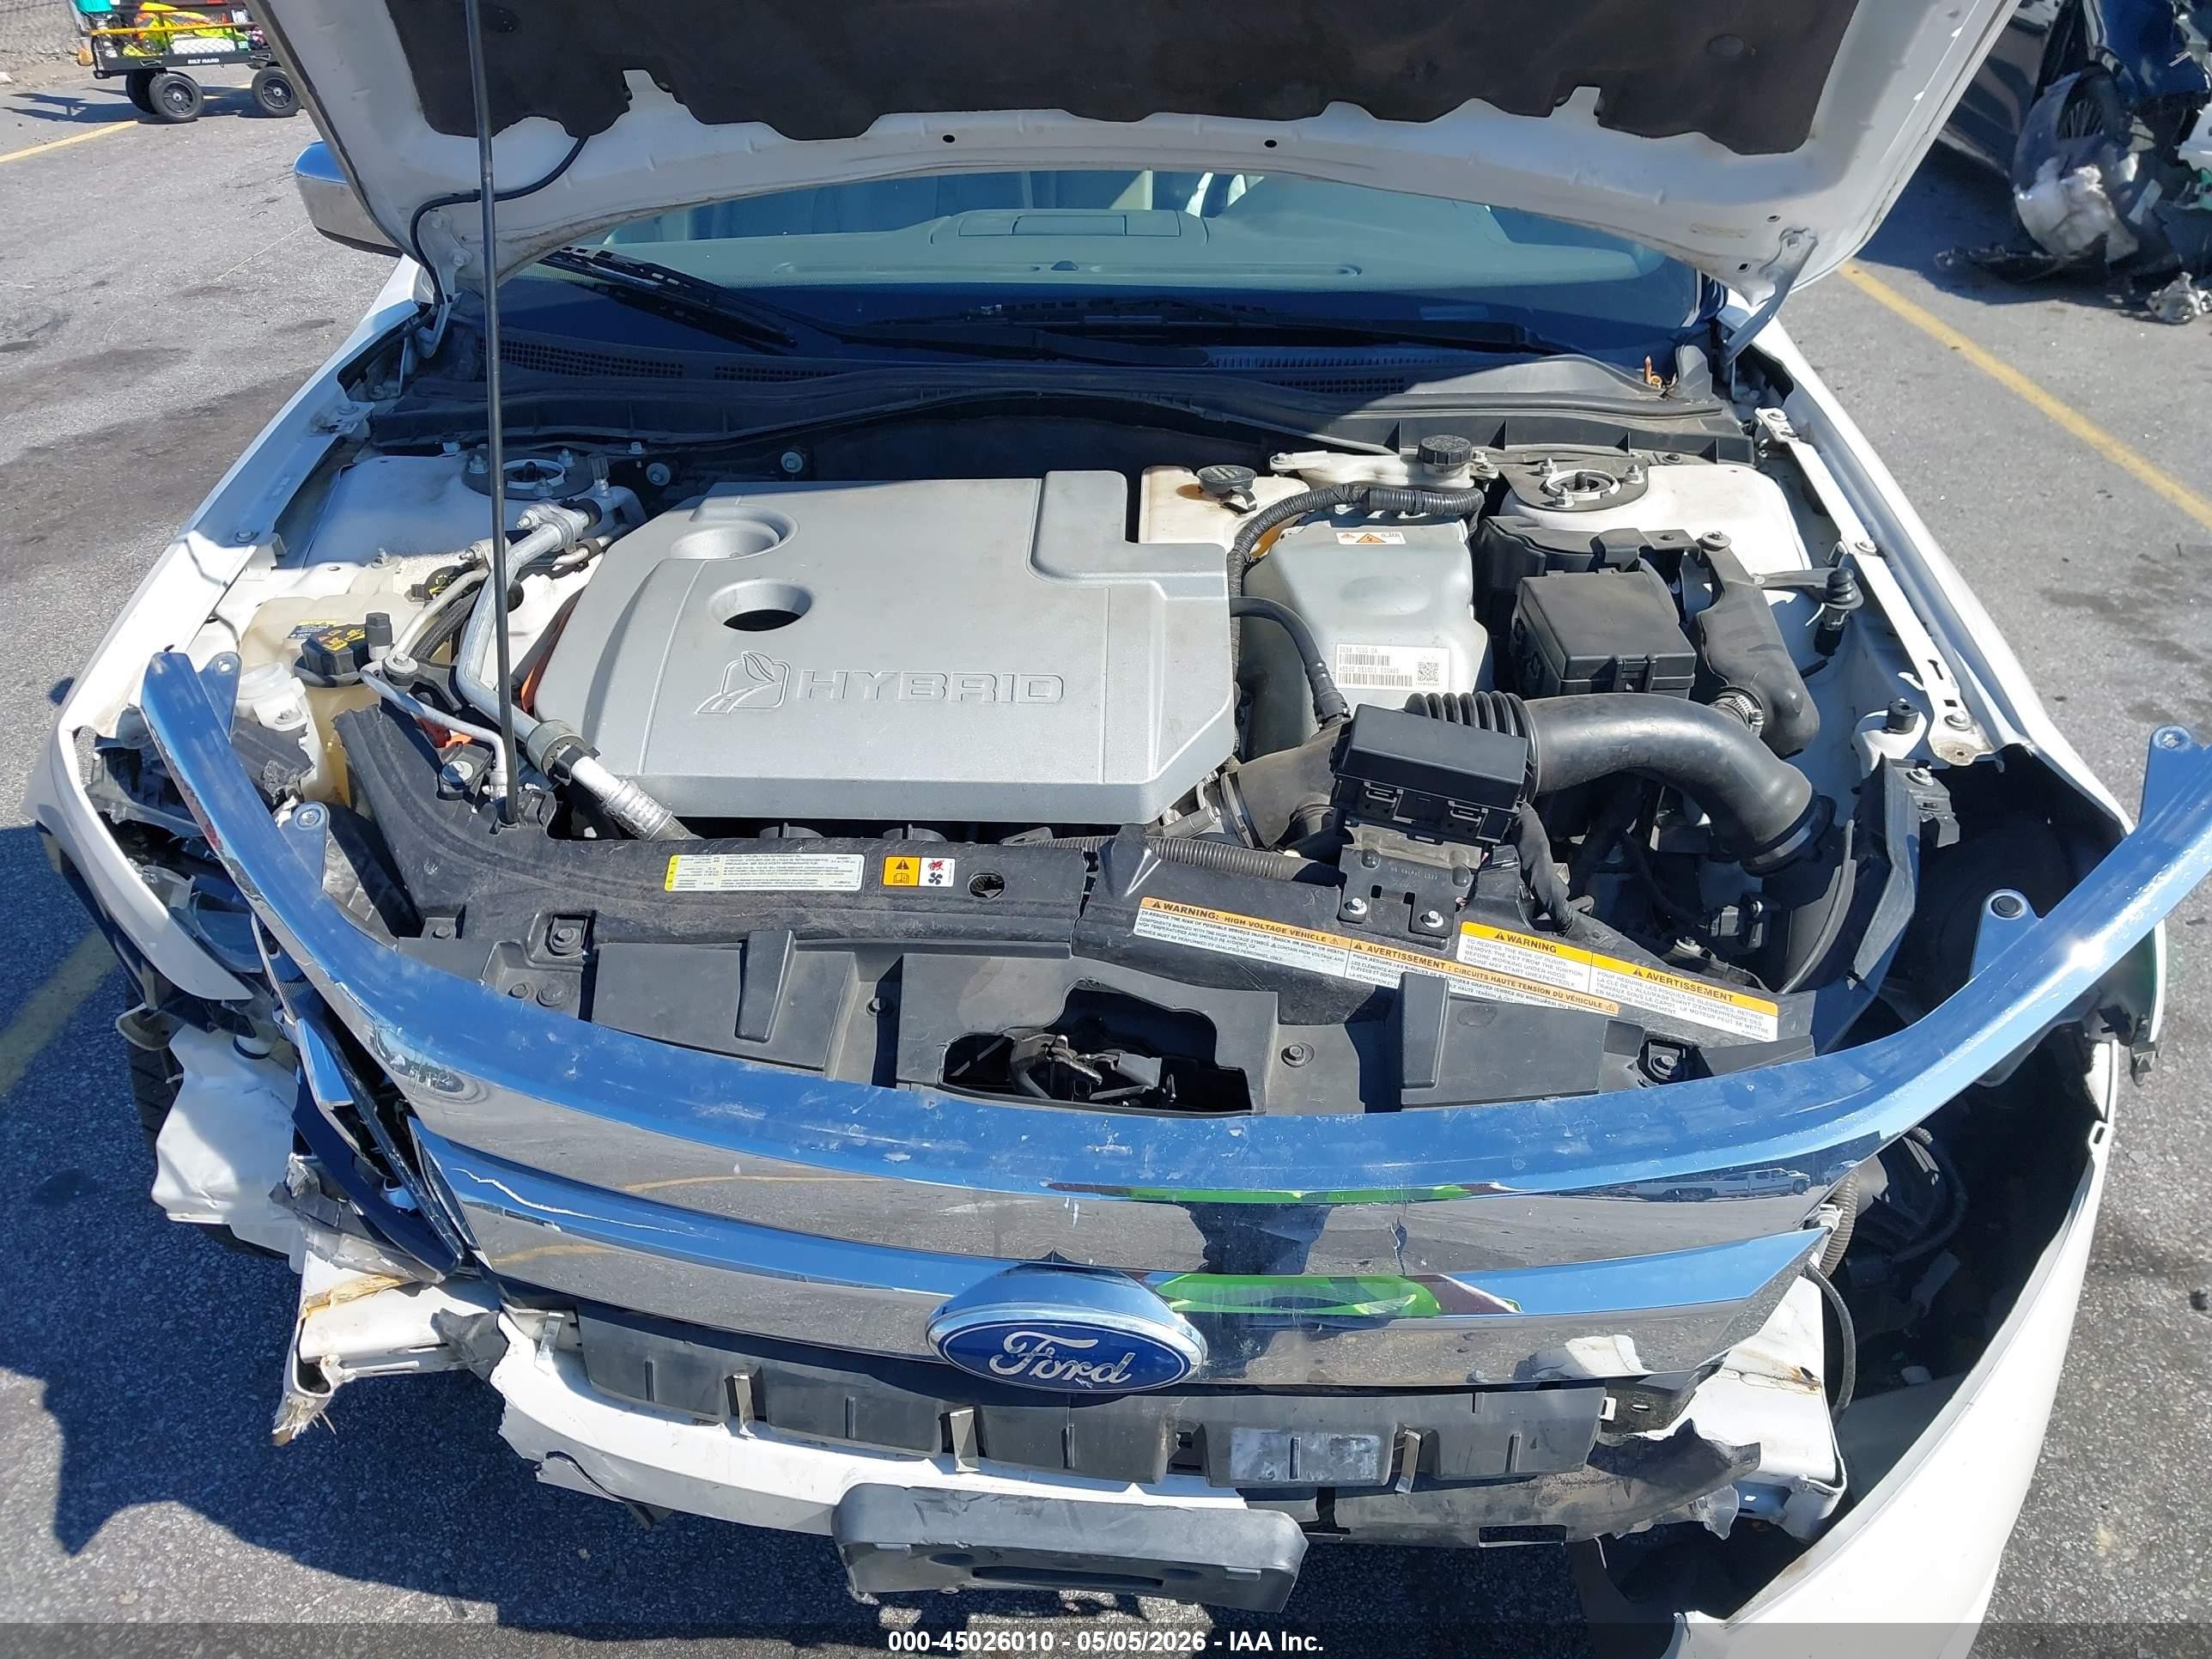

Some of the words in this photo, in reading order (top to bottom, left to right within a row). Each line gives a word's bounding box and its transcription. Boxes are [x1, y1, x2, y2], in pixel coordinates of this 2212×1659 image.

[797, 671, 1063, 703] HYBRID
[1163, 902, 1219, 920] WARNING:
[1224, 916, 1245, 925] HIGH
[1248, 921, 1286, 933] VOLTAGE
[1288, 929, 1327, 942] VEHICLE
[1506, 934, 1557, 952] WARNING
[1367, 945, 1446, 969] AVERTISSEMENT
[1454, 967, 1489, 980] CIRCUITS
[1491, 975, 1516, 987] HAUTE
[1518, 982, 1550, 995] TENSION
[1565, 993, 1602, 1008] VÉHICULE
[1646, 971, 1733, 1001] AVERTISSEMENT
[989, 1330, 1136, 1384] Ford
